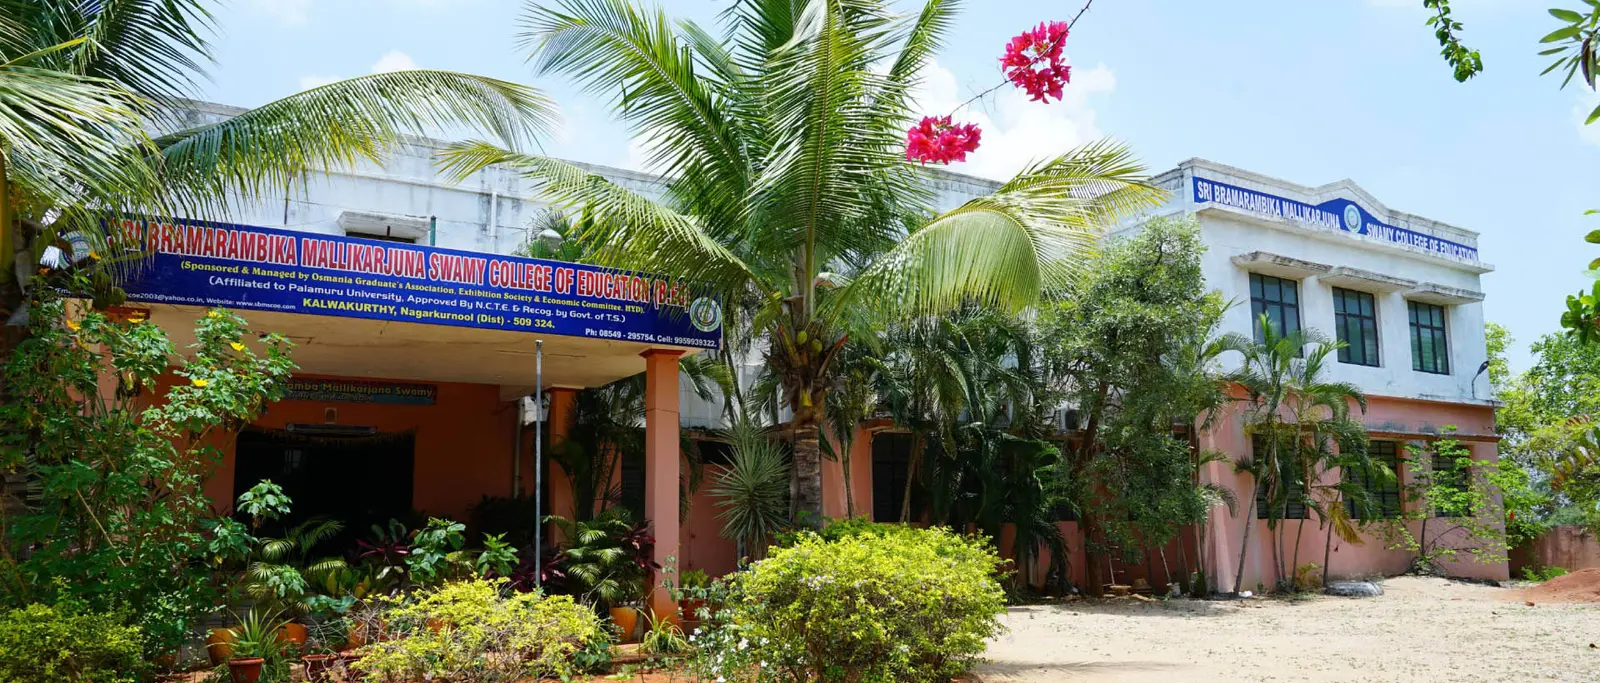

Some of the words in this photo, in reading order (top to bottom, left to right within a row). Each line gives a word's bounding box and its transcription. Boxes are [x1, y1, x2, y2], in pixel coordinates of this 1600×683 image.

[1197, 181, 1212, 202] SRI
[1214, 184, 1281, 217] BRAMARAMBIKA
[1282, 200, 1341, 230] MALLIKARJUNA
[1366, 222, 1394, 243] SWAMY
[1395, 229, 1429, 250] COLLEGE
[1429, 238, 1439, 252] OF
[1440, 241, 1479, 261] EDUCATION
[146, 220, 298, 267] BRAMARAMBIKA
[301, 238, 427, 280] MALLIKARJUNA
[428, 251, 487, 286] SWAMY
[489, 258, 553, 293] COLLEGE
[555, 267, 574, 295] OF
[576, 269, 650, 304] EDUCATION
[180, 260, 239, 275] (Sponsored
[241, 266, 249, 275] &
[252, 266, 296, 280] Managed
[298, 271, 309, 282] by
[311, 272, 353, 284] Osmania
[355, 277, 403, 290] Graduate's
[459, 287, 502, 299] Exhibition
[503, 292, 532, 303] Society
[542, 295, 579, 307] Economic
[206, 297, 235, 306] Website:
[209, 275, 271, 290] (Affiliated
[273, 281, 286, 291] to
[288, 283, 343, 297] Palamuru
[407, 293, 457, 307] Approved
[459, 299, 473, 310] By
[512, 304, 520, 312] &
[523, 305, 554, 317] Recog.
[556, 309, 567, 318] by
[569, 310, 593, 320] Govt.
[594, 313, 605, 321] of
[606, 313, 626, 324] T.S.)
[302, 297, 397, 317] KALWAKURTHY,
[400, 306, 474, 322] Nagarkurnool
[477, 313, 505, 326] (Dist)
[513, 317, 532, 328] 509
[534, 319, 555, 329] 324.
[585, 328, 598, 337] Ph:
[599, 329, 622, 339] 08549
[657, 334, 673, 344] Cell:
[395, 386, 433, 398] Swamy
